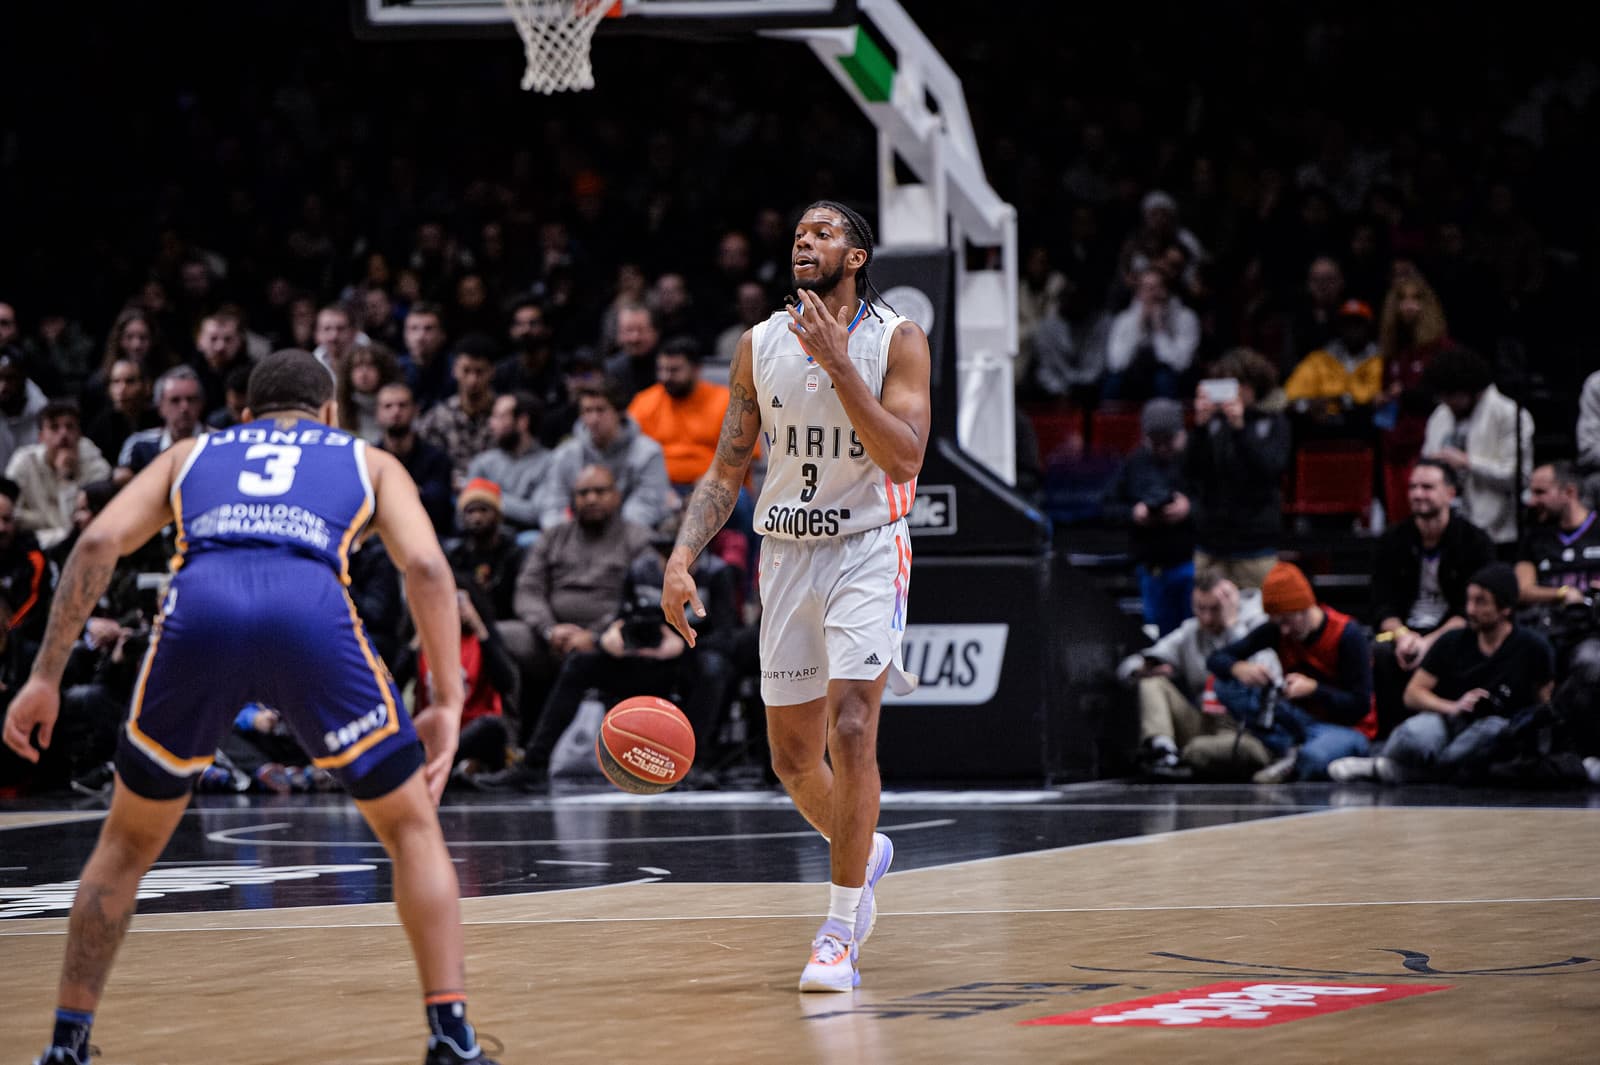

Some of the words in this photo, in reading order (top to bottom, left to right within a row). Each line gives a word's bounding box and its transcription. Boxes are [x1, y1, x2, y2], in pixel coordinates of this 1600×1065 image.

[211, 429, 352, 446] JONES
[771, 424, 865, 459] ARIS
[237, 443, 302, 496] 3
[800, 463, 817, 503] 3
[765, 505, 839, 539] snipes
[761, 666, 817, 679] OURTYARD
[622, 751, 676, 779] LEGACY
